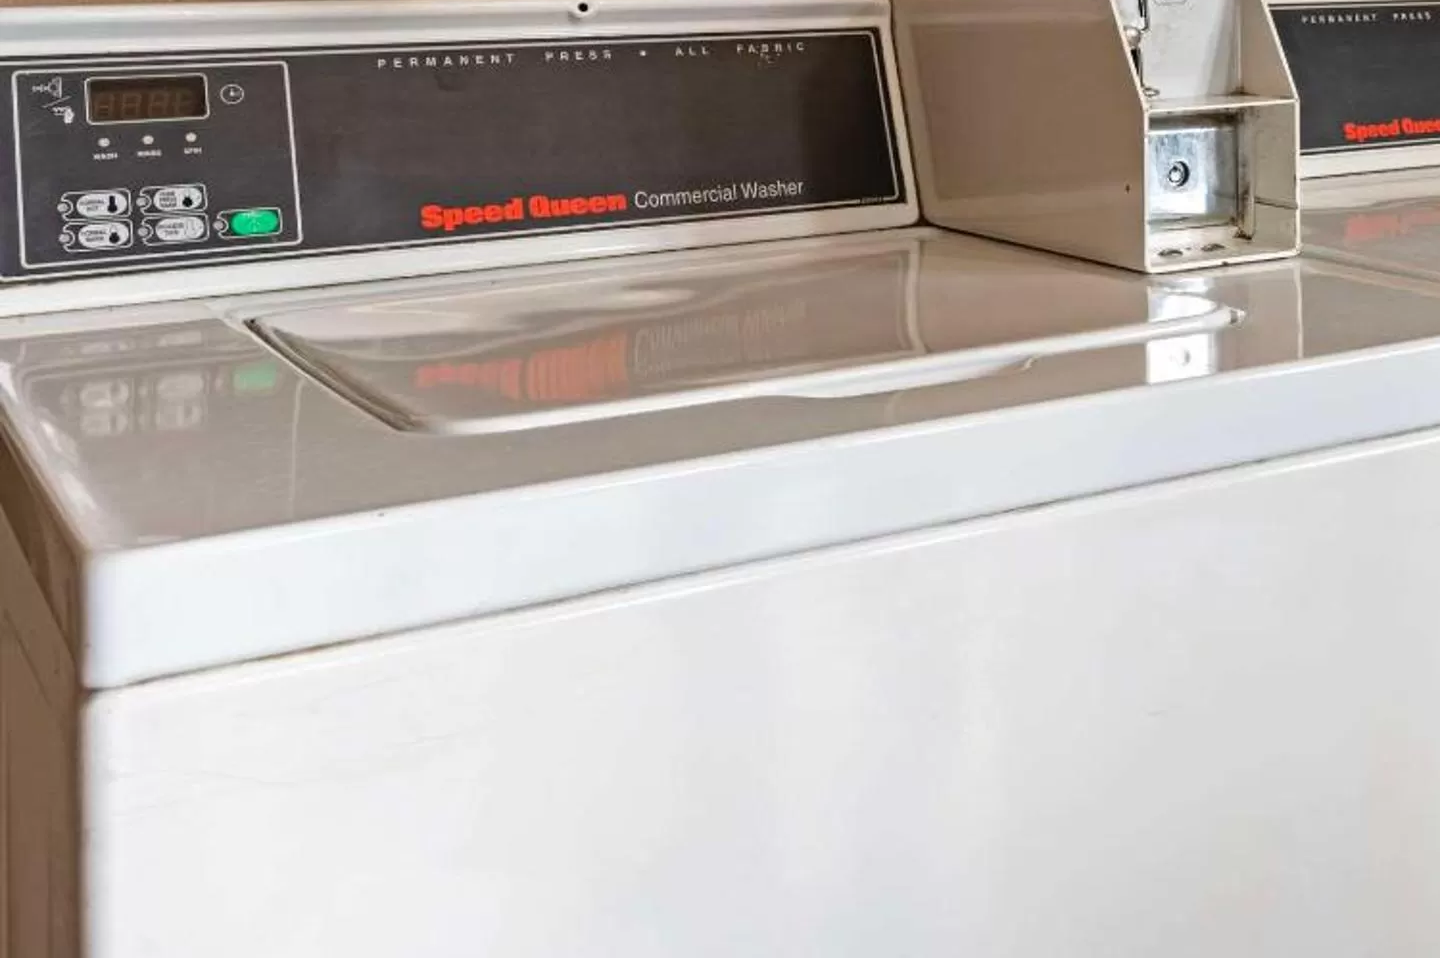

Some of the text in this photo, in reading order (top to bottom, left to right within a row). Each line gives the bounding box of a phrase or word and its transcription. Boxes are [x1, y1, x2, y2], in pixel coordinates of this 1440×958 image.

[377, 41, 805, 69] PERMANENT PRESS ALL FABRIC
[1343, 118, 1400, 142] Speed
[420, 180, 804, 232] Speed Queen Commercial Washer
